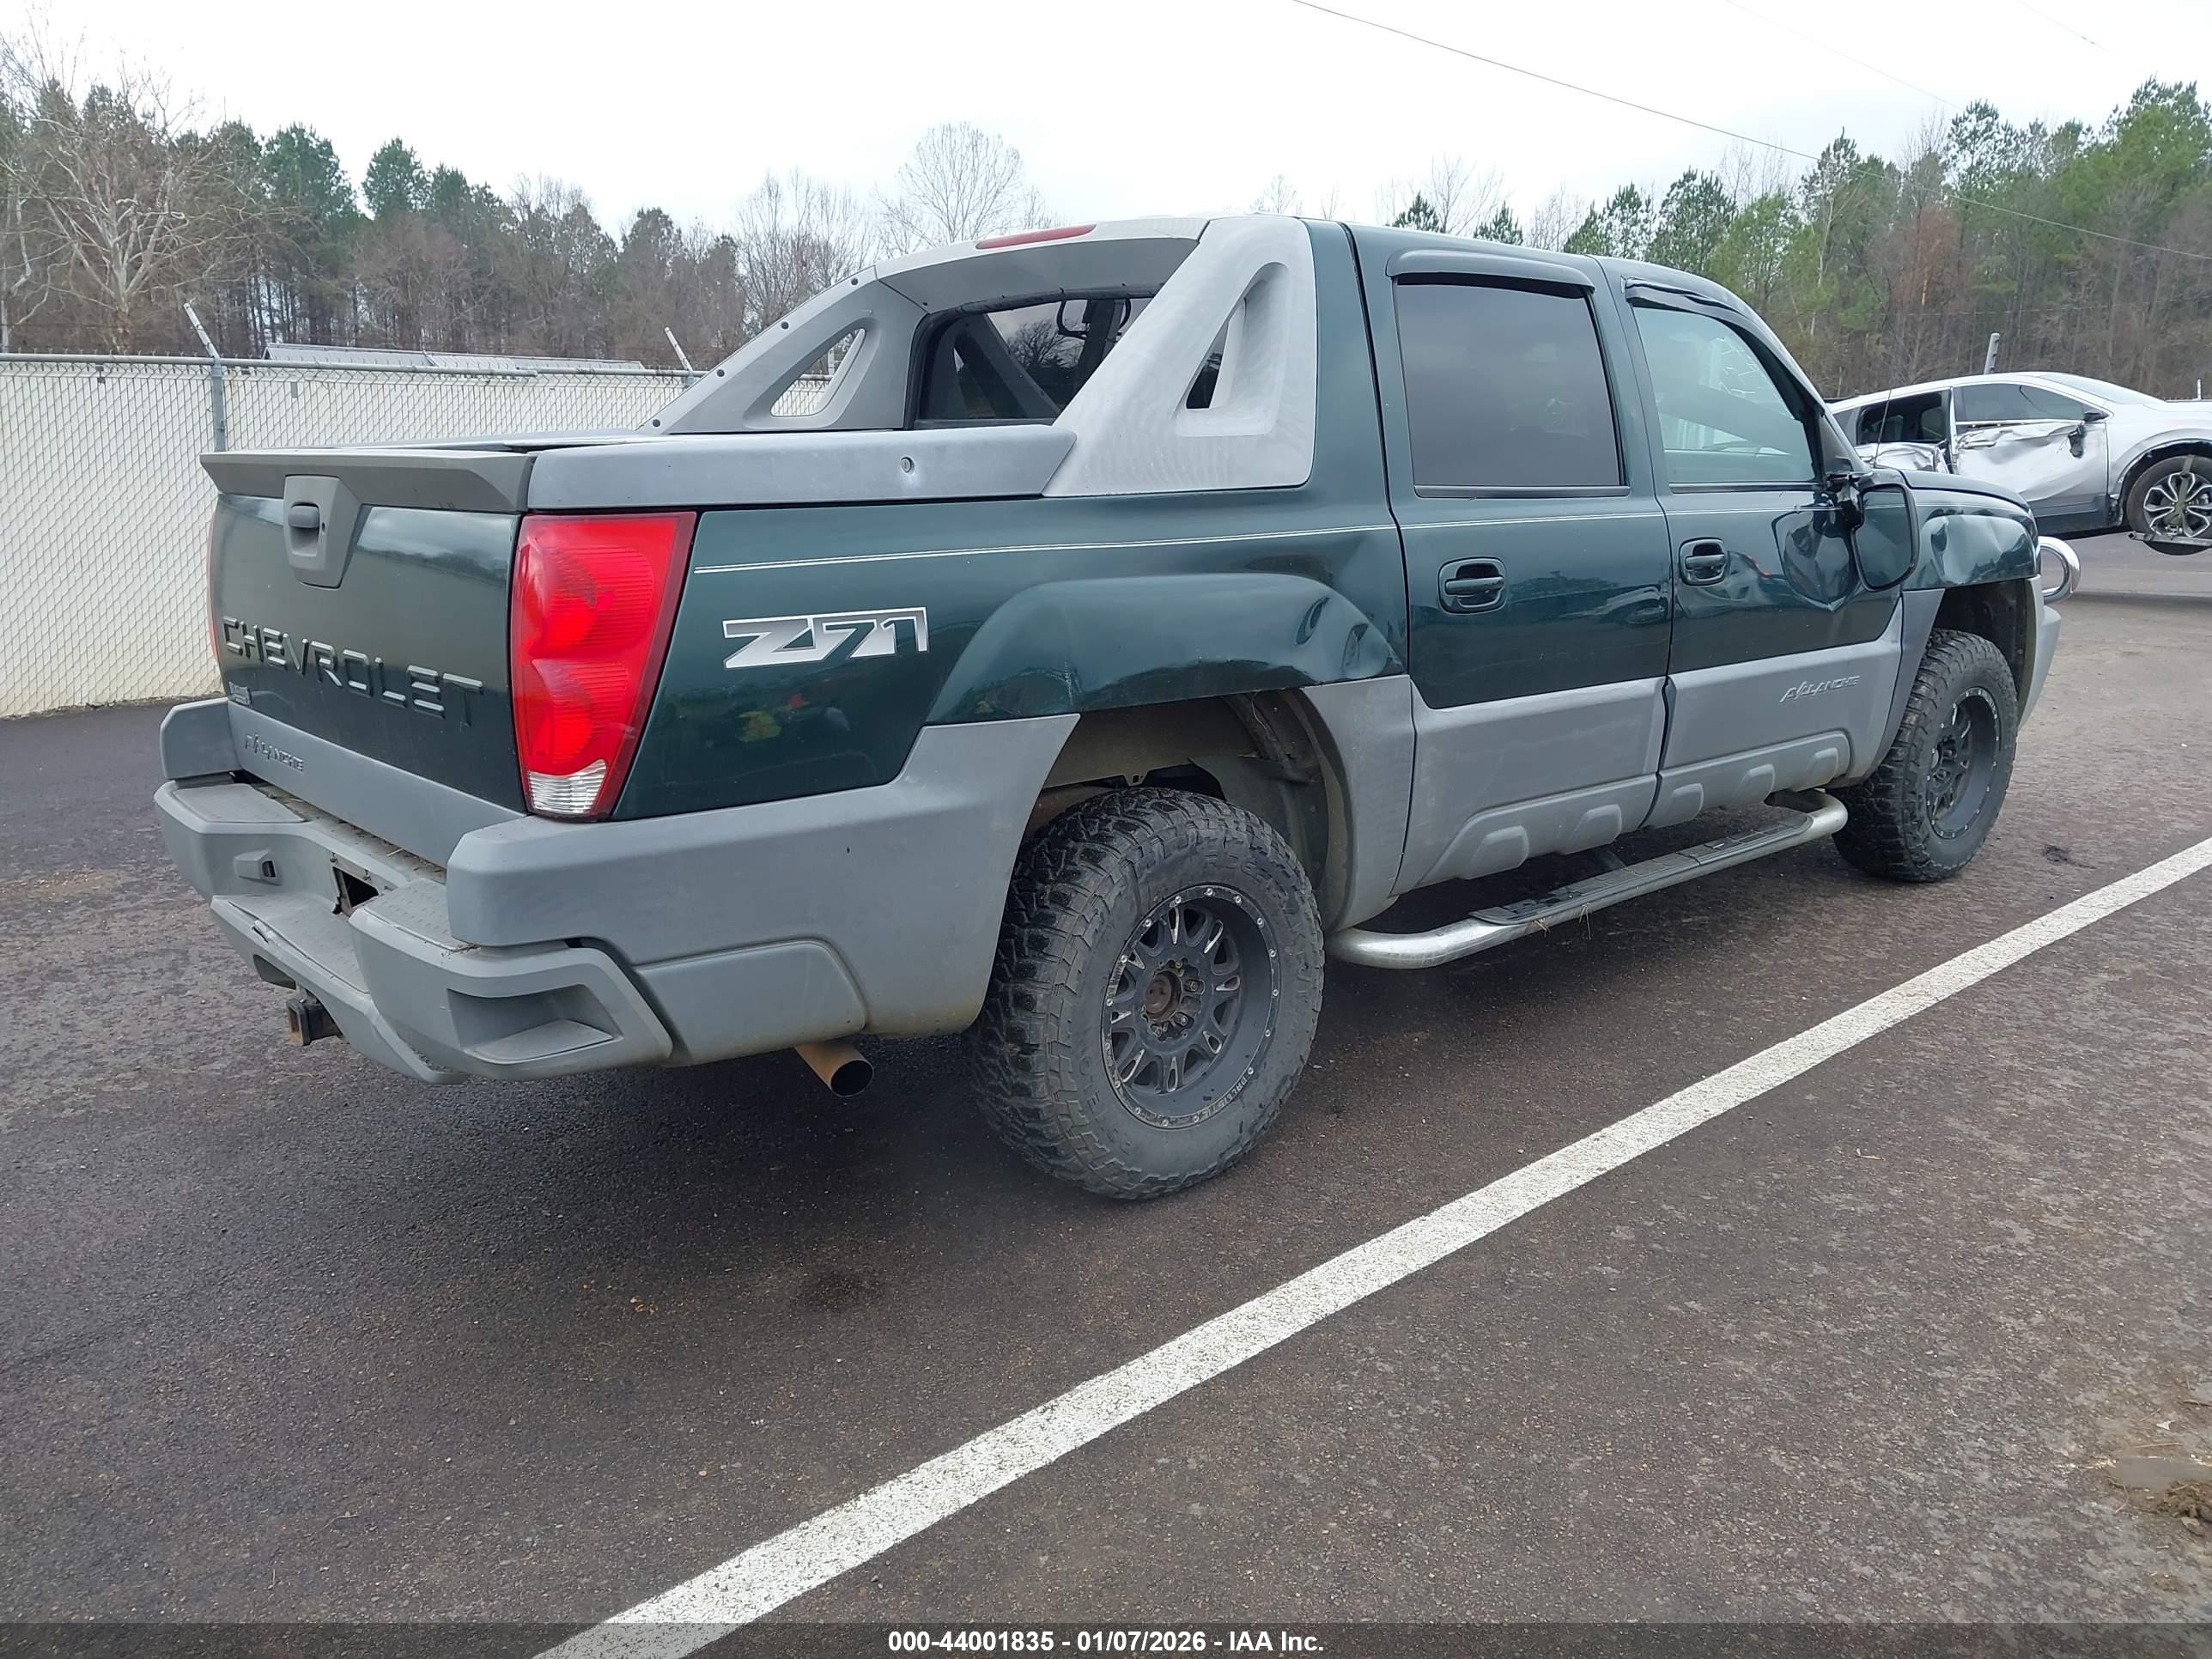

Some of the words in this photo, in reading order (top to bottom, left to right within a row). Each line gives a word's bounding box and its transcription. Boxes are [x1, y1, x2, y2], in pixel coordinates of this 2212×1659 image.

[722, 606, 929, 670] Z71
[222, 616, 483, 728] CHEVROLET
[1779, 675, 1861, 702] AVALANCHE
[245, 734, 303, 773] AVALANCHE
